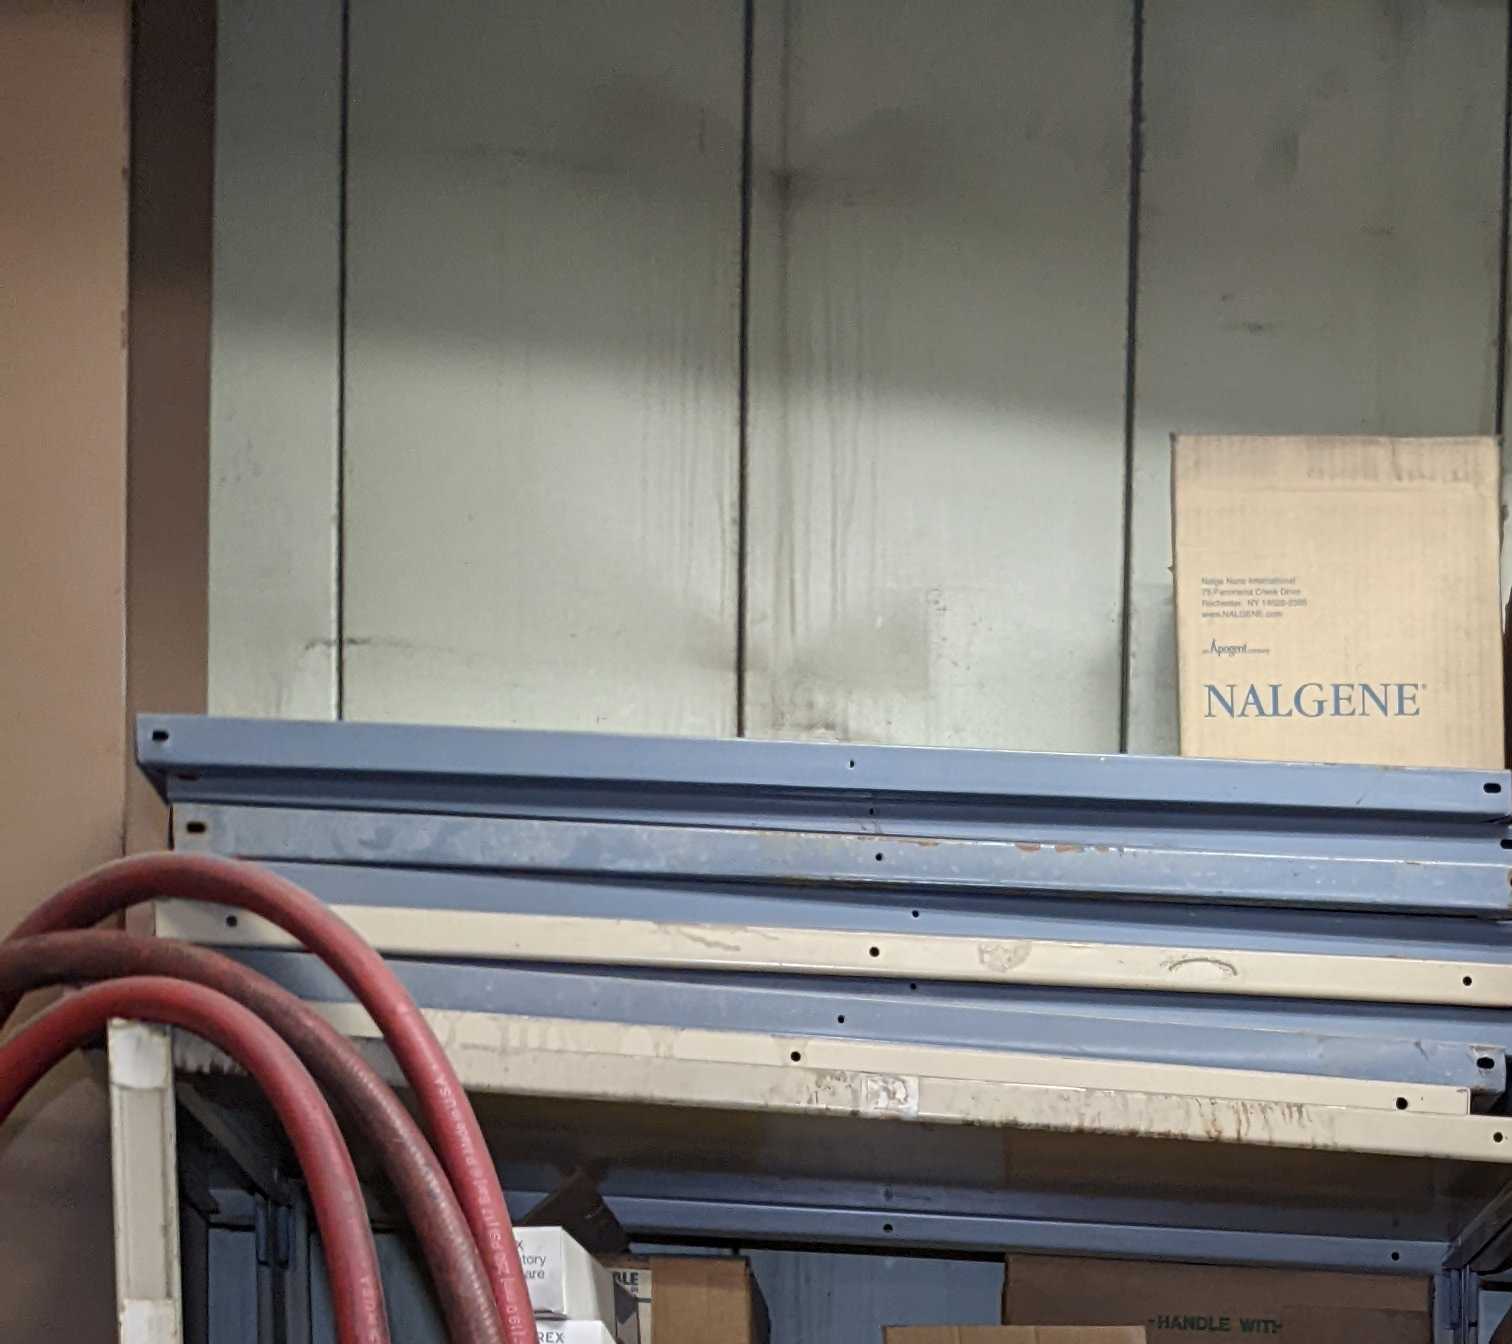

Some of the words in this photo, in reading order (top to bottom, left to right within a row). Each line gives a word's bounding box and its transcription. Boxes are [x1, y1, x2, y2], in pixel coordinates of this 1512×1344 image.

[1210, 638, 1247, 657] Apogent
[1204, 682, 1422, 719] NALGENE
[1158, 1316, 1231, 1332] HANDLE
